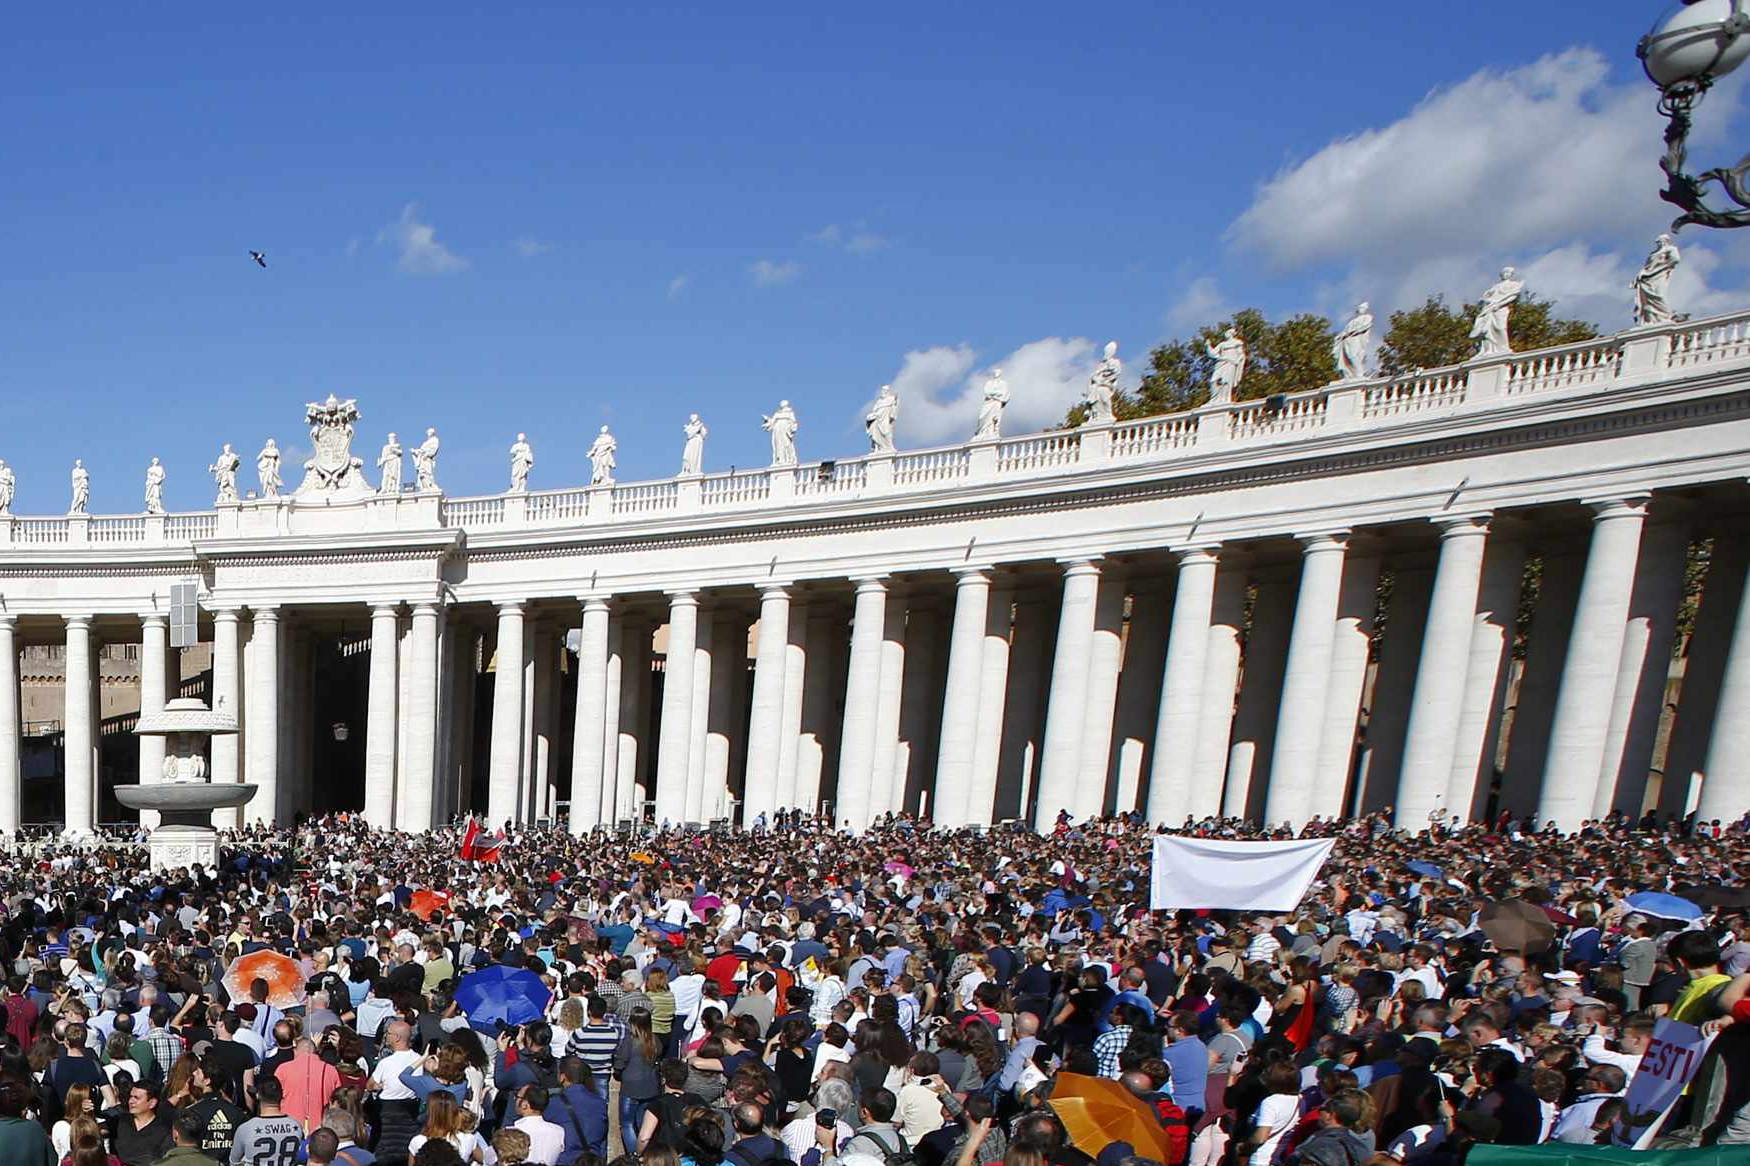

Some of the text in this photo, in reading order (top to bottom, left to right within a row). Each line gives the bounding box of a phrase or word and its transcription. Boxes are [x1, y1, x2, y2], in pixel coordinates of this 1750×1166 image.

[207, 1122, 232, 1131] adidas
[265, 1123, 291, 1134] SWAG
[202, 1138, 234, 1150] Emirate
